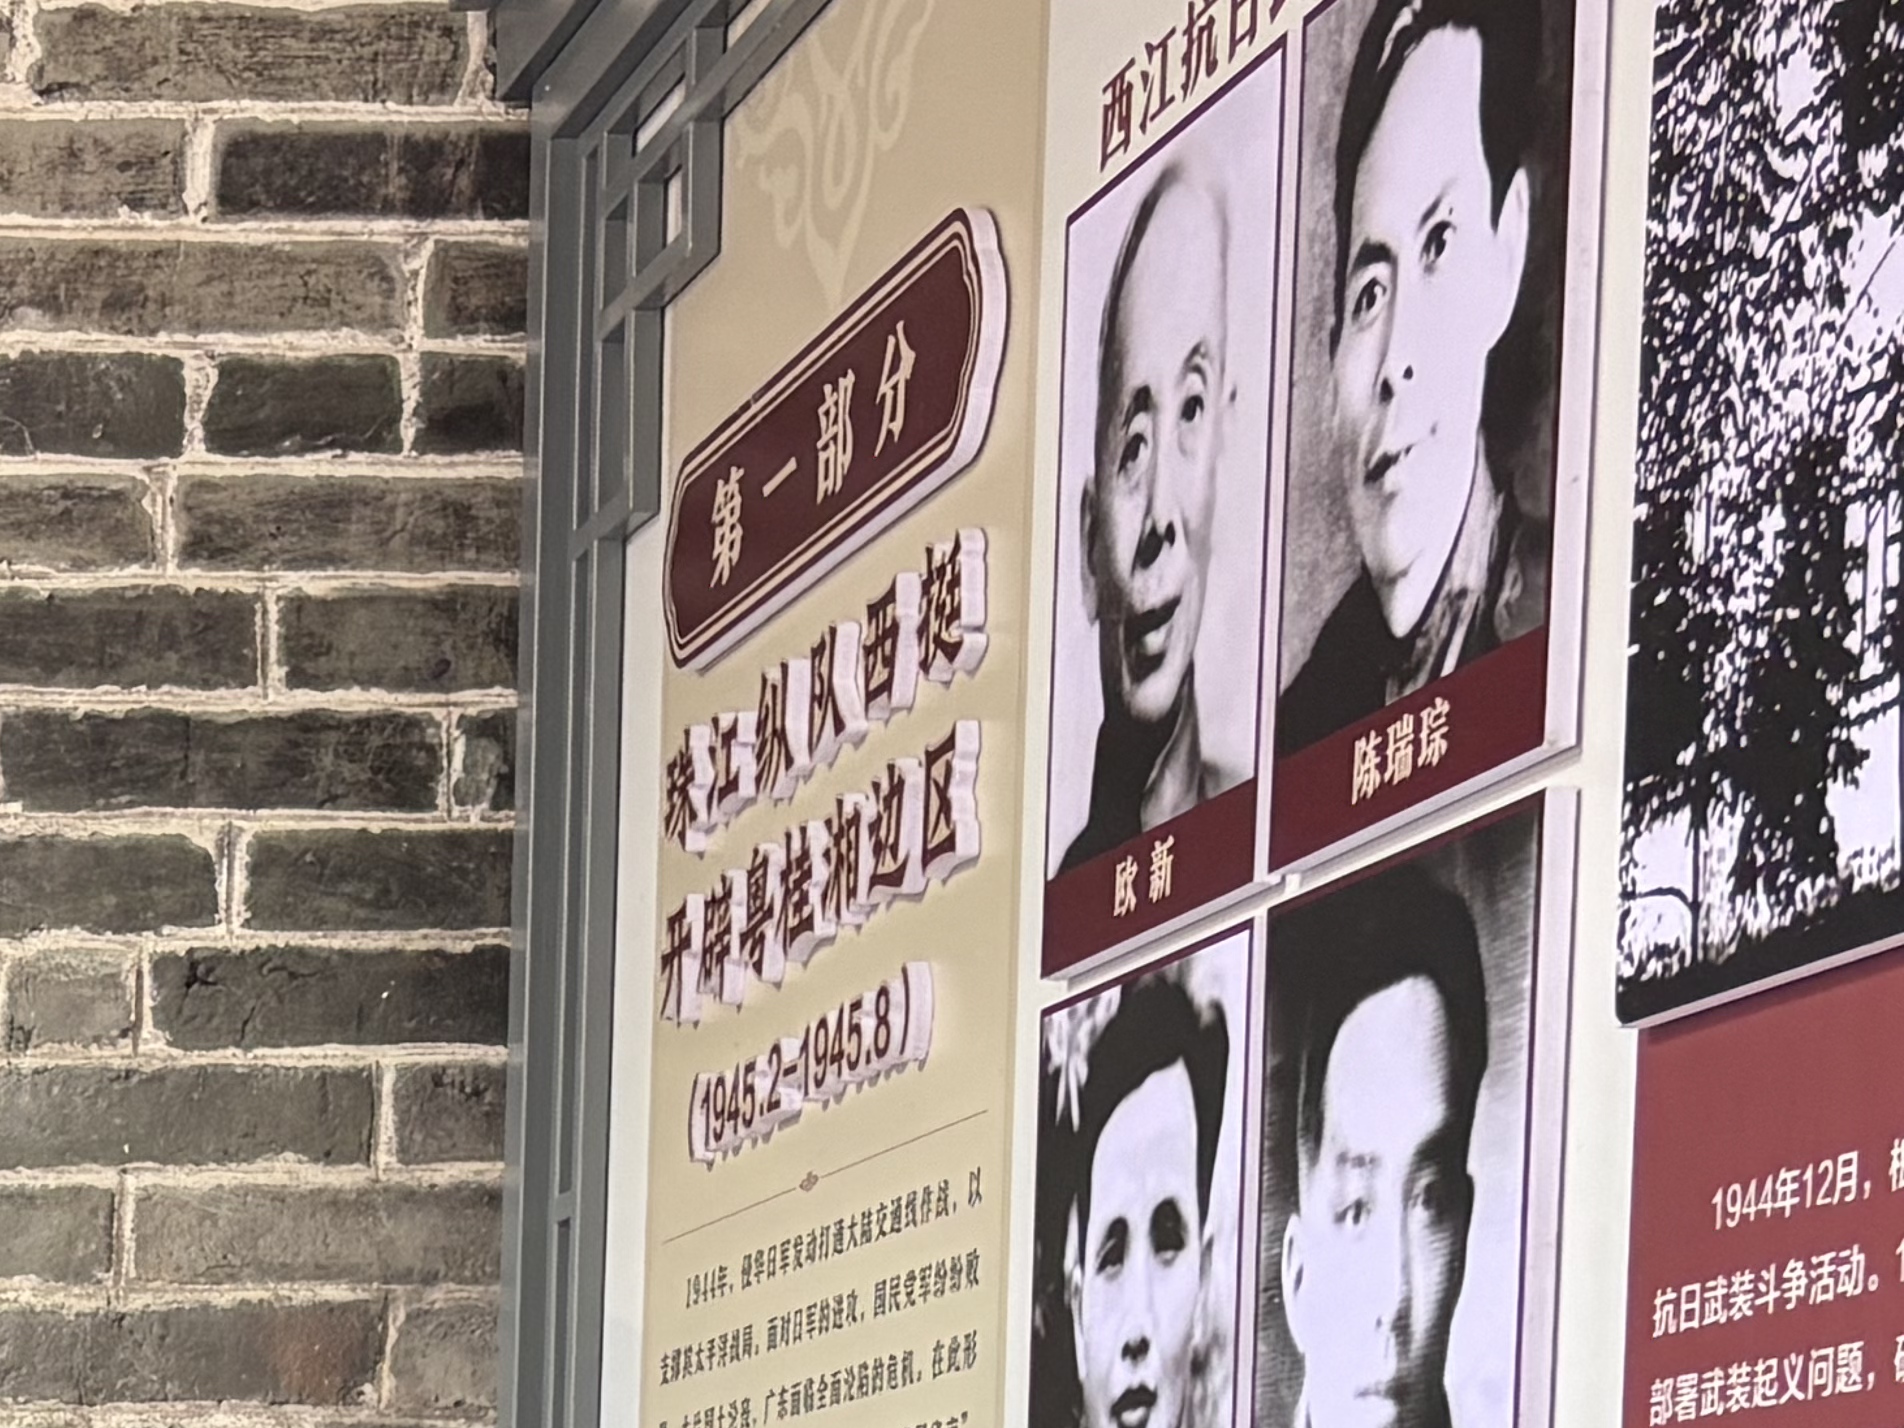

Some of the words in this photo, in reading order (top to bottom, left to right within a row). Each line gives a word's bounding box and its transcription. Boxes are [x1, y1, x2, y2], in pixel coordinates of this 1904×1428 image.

[707, 320, 917, 585] 第一部分
[665, 527, 988, 852] 珠江纵队西挺
[1350, 703, 1452, 803] 陈瑞琮
[660, 719, 981, 1026] 开辟粤桂湘边区
[1112, 835, 1178, 919] 欧新
